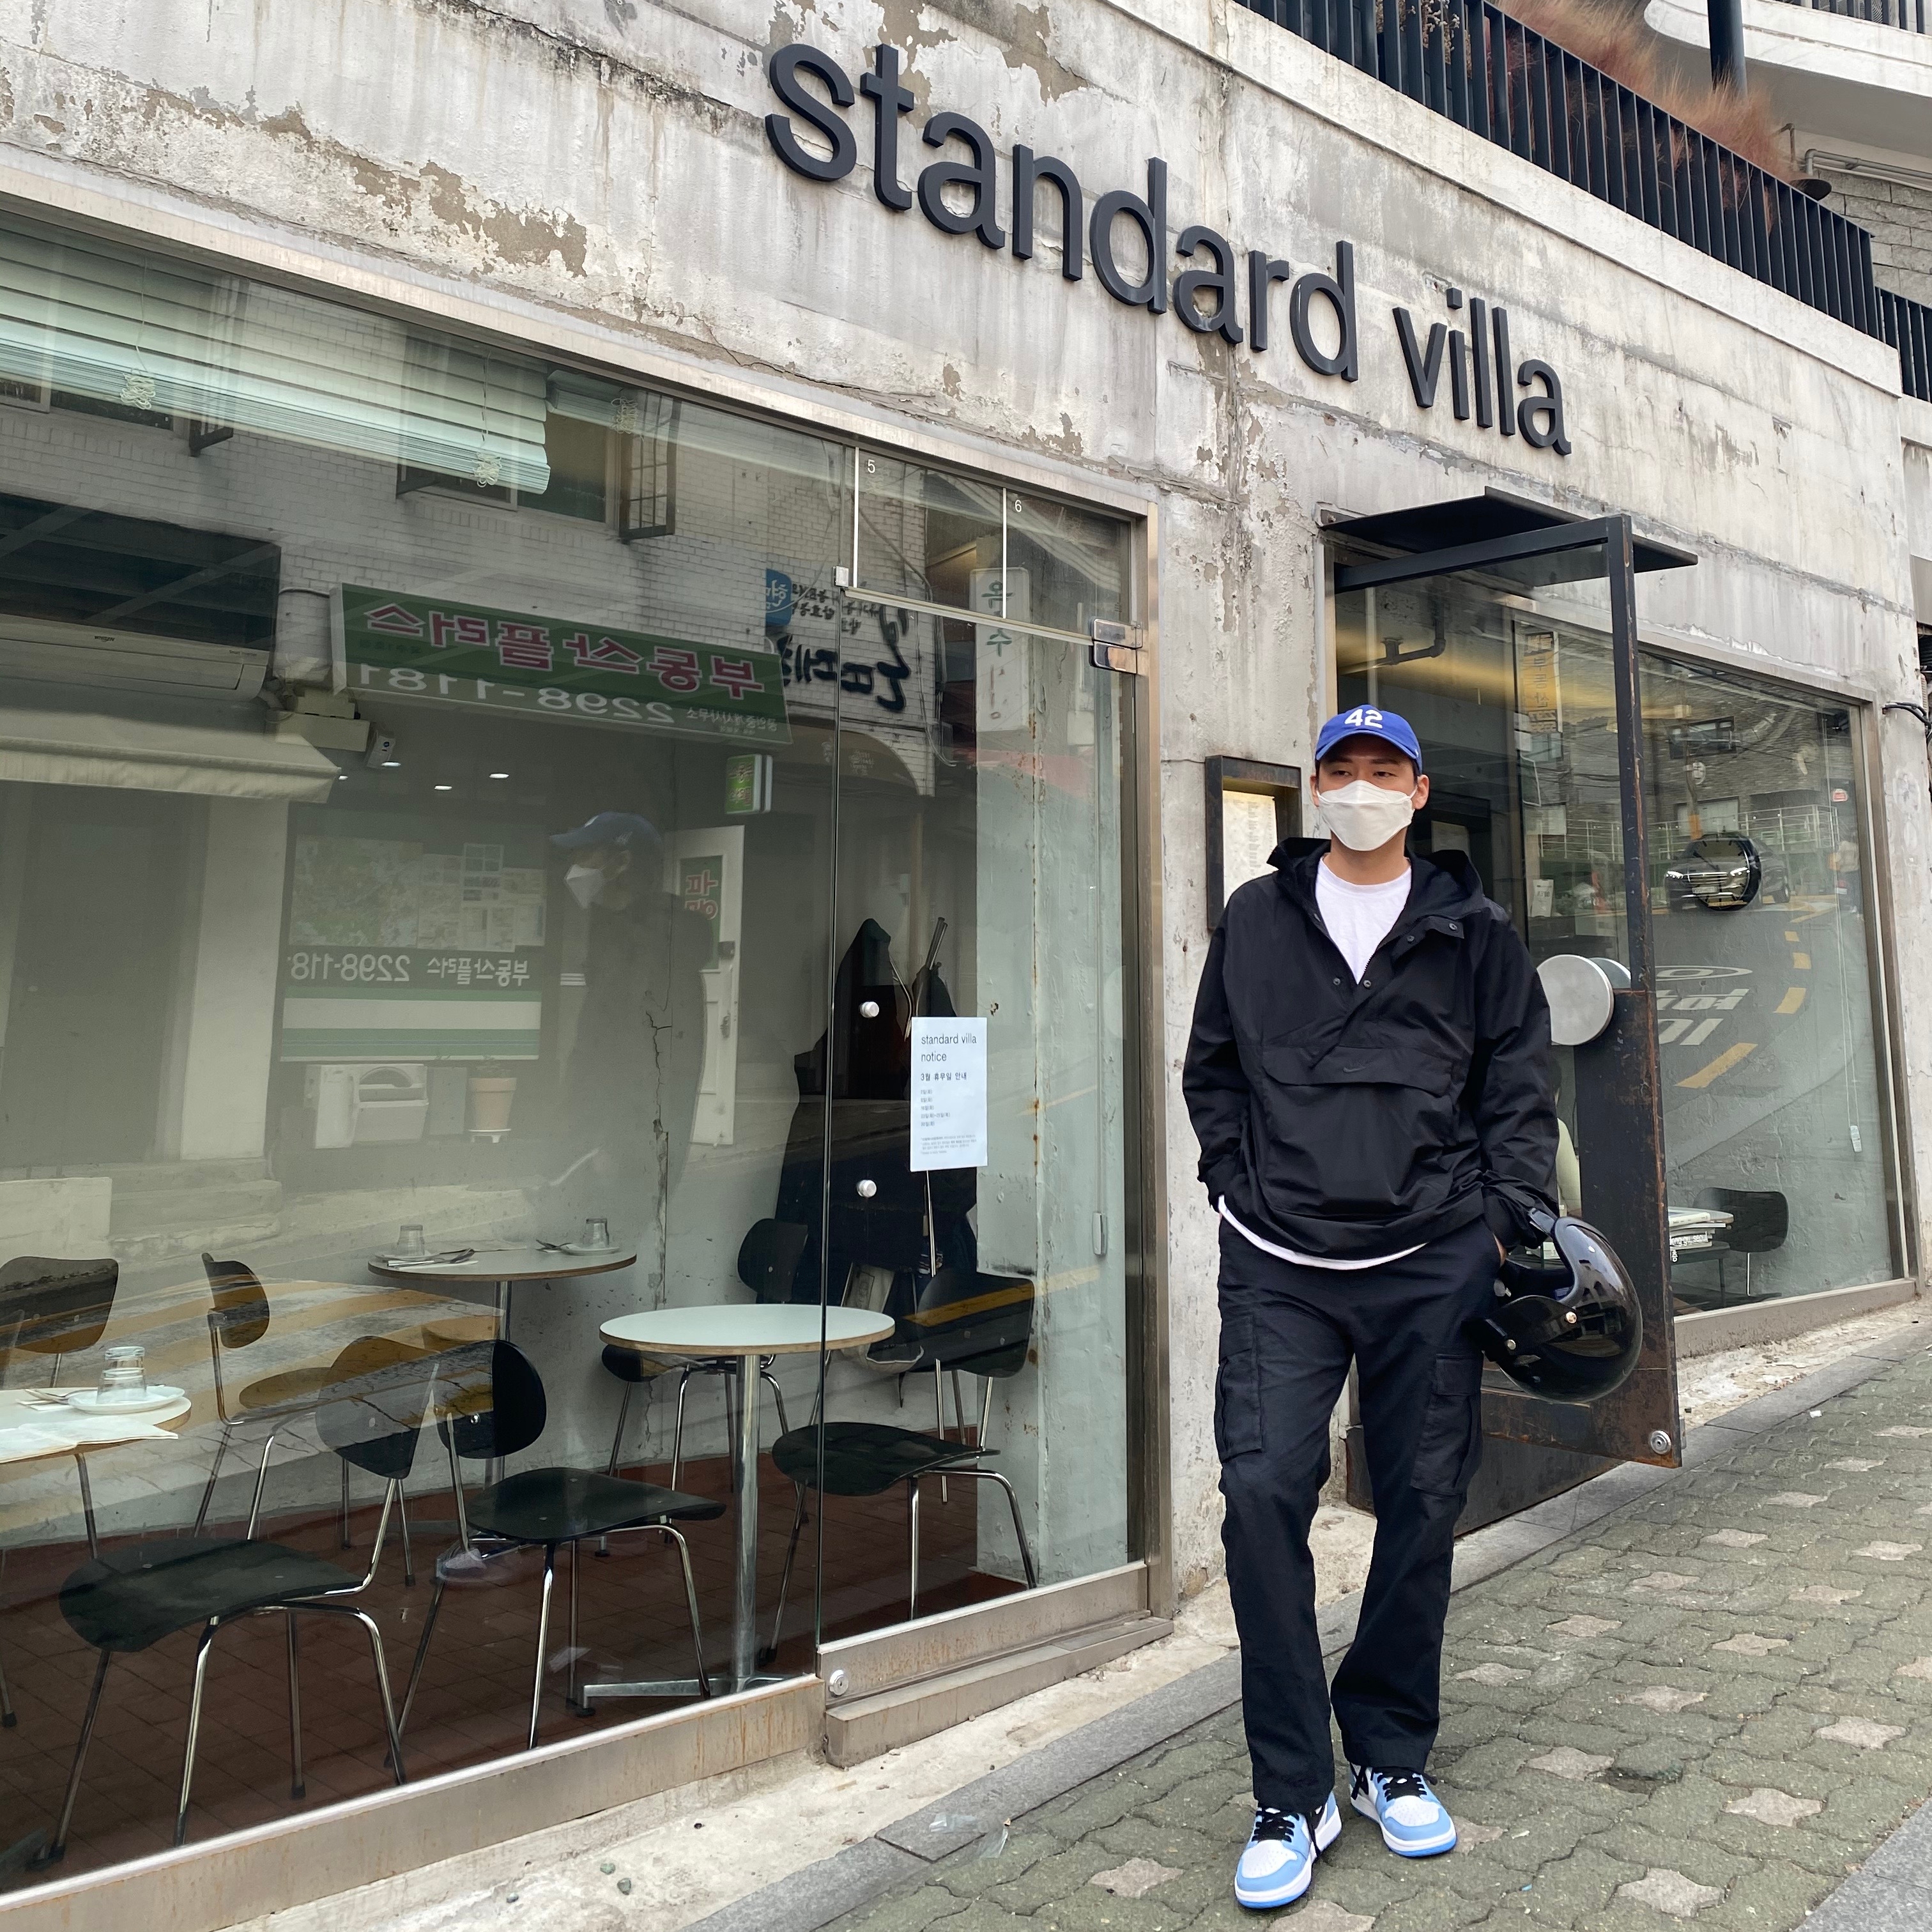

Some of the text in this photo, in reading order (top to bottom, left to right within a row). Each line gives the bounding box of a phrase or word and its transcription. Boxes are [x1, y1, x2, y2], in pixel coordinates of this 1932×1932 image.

[766, 43, 1571, 455] standard villa
[866, 459, 876, 473] 5
[1014, 499, 1022, 512] 6
[1344, 709, 1383, 729] 42
[921, 1032, 977, 1045] standard villa
[921, 1050, 947, 1062] notice
